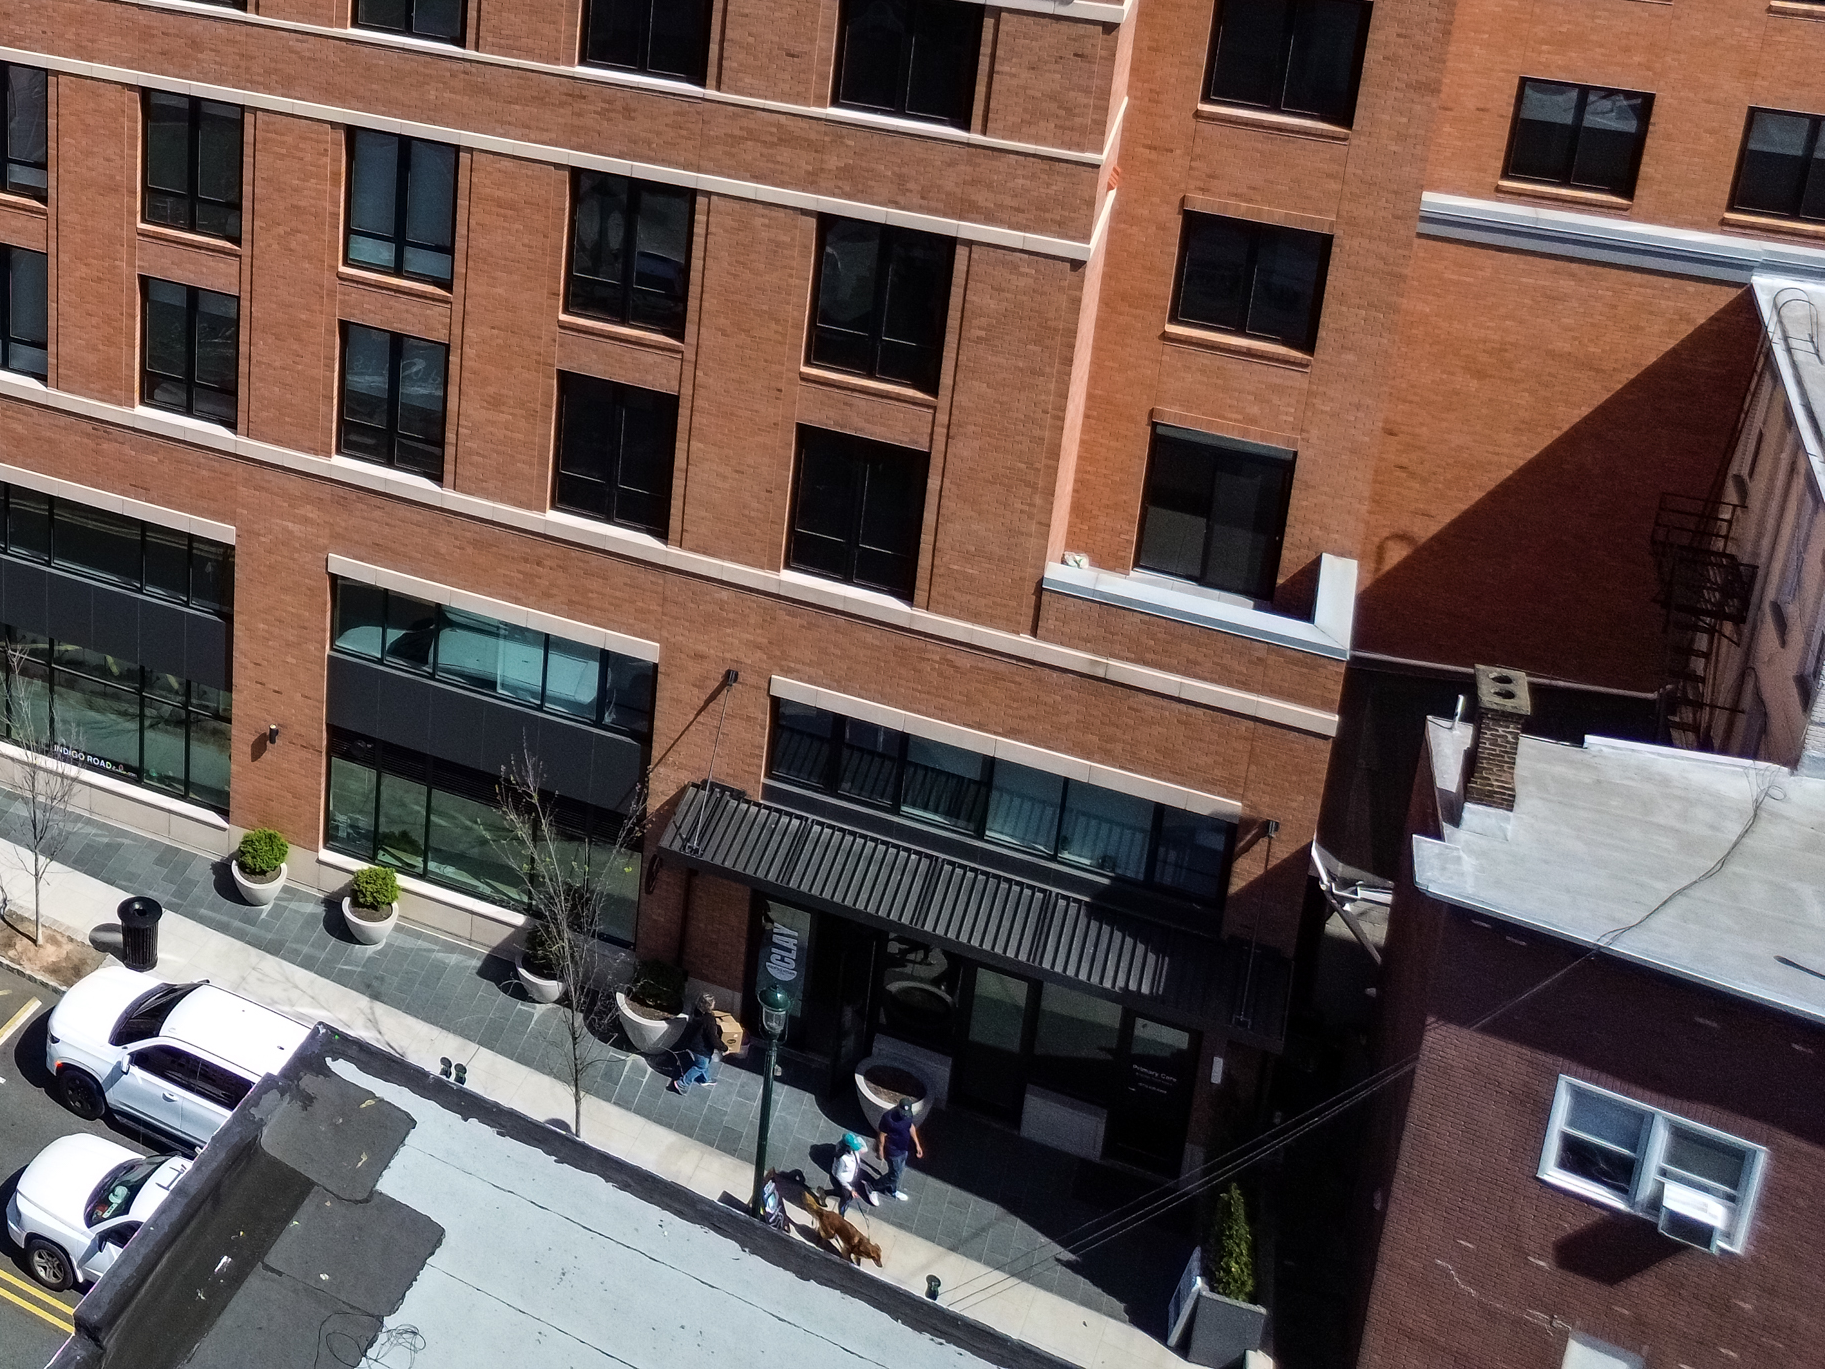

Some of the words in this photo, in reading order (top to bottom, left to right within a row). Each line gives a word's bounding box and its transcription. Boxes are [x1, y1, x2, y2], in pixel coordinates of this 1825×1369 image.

[54, 744, 85, 761] INDIGO
[87, 755, 112, 769] ROAD
[770, 922, 798, 969] CLAY
